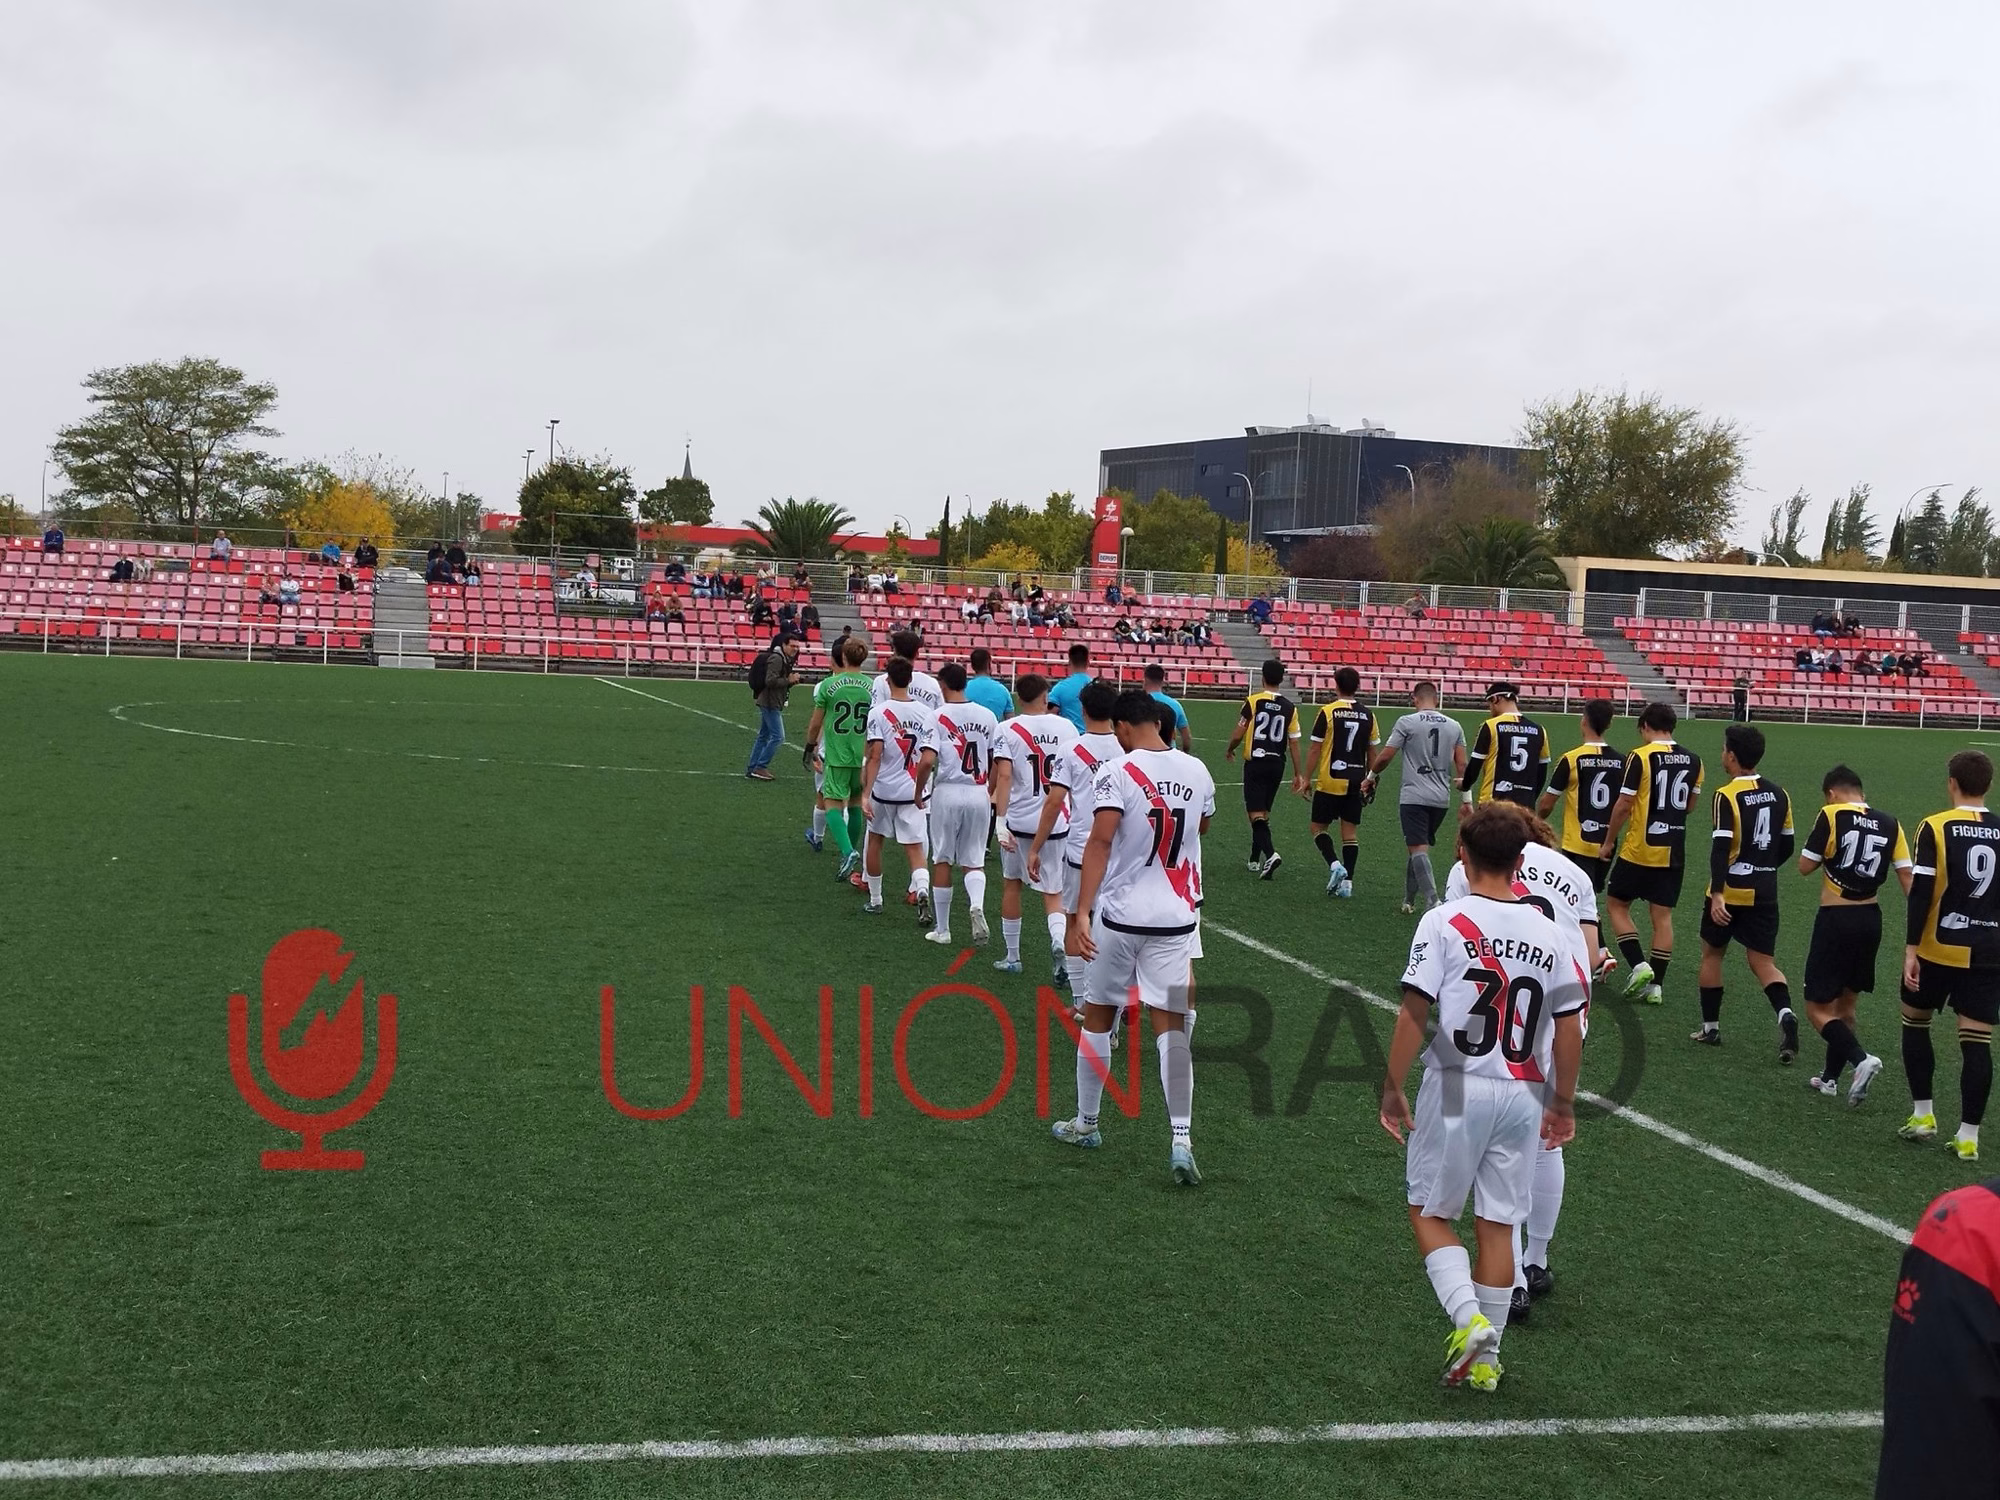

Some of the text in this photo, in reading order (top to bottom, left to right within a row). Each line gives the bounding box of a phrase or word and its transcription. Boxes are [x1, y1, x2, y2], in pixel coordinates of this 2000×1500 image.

[833, 701, 869, 735] 25
[1253, 711, 1286, 742] 20
[1344, 721, 1360, 752] 7
[902, 733, 918, 771] 7
[1033, 734, 1059, 746] BALA
[1427, 727, 1439, 758] 1
[1509, 735, 1529, 772] 5
[960, 741, 982, 779] 4
[1590, 771, 1610, 810] 6
[1655, 769, 1690, 810] 16
[1144, 807, 1186, 869] 11
[1752, 806, 1772, 850] 4
[1853, 815, 1880, 831] MORE
[1952, 825, 2000, 840] FIGUERO
[1840, 830, 1889, 879] 15
[1966, 844, 1997, 899] 9
[1513, 866, 1579, 907] AS SIAS
[1463, 937, 1555, 974] BECERRA
[1453, 967, 1544, 1064] 30
